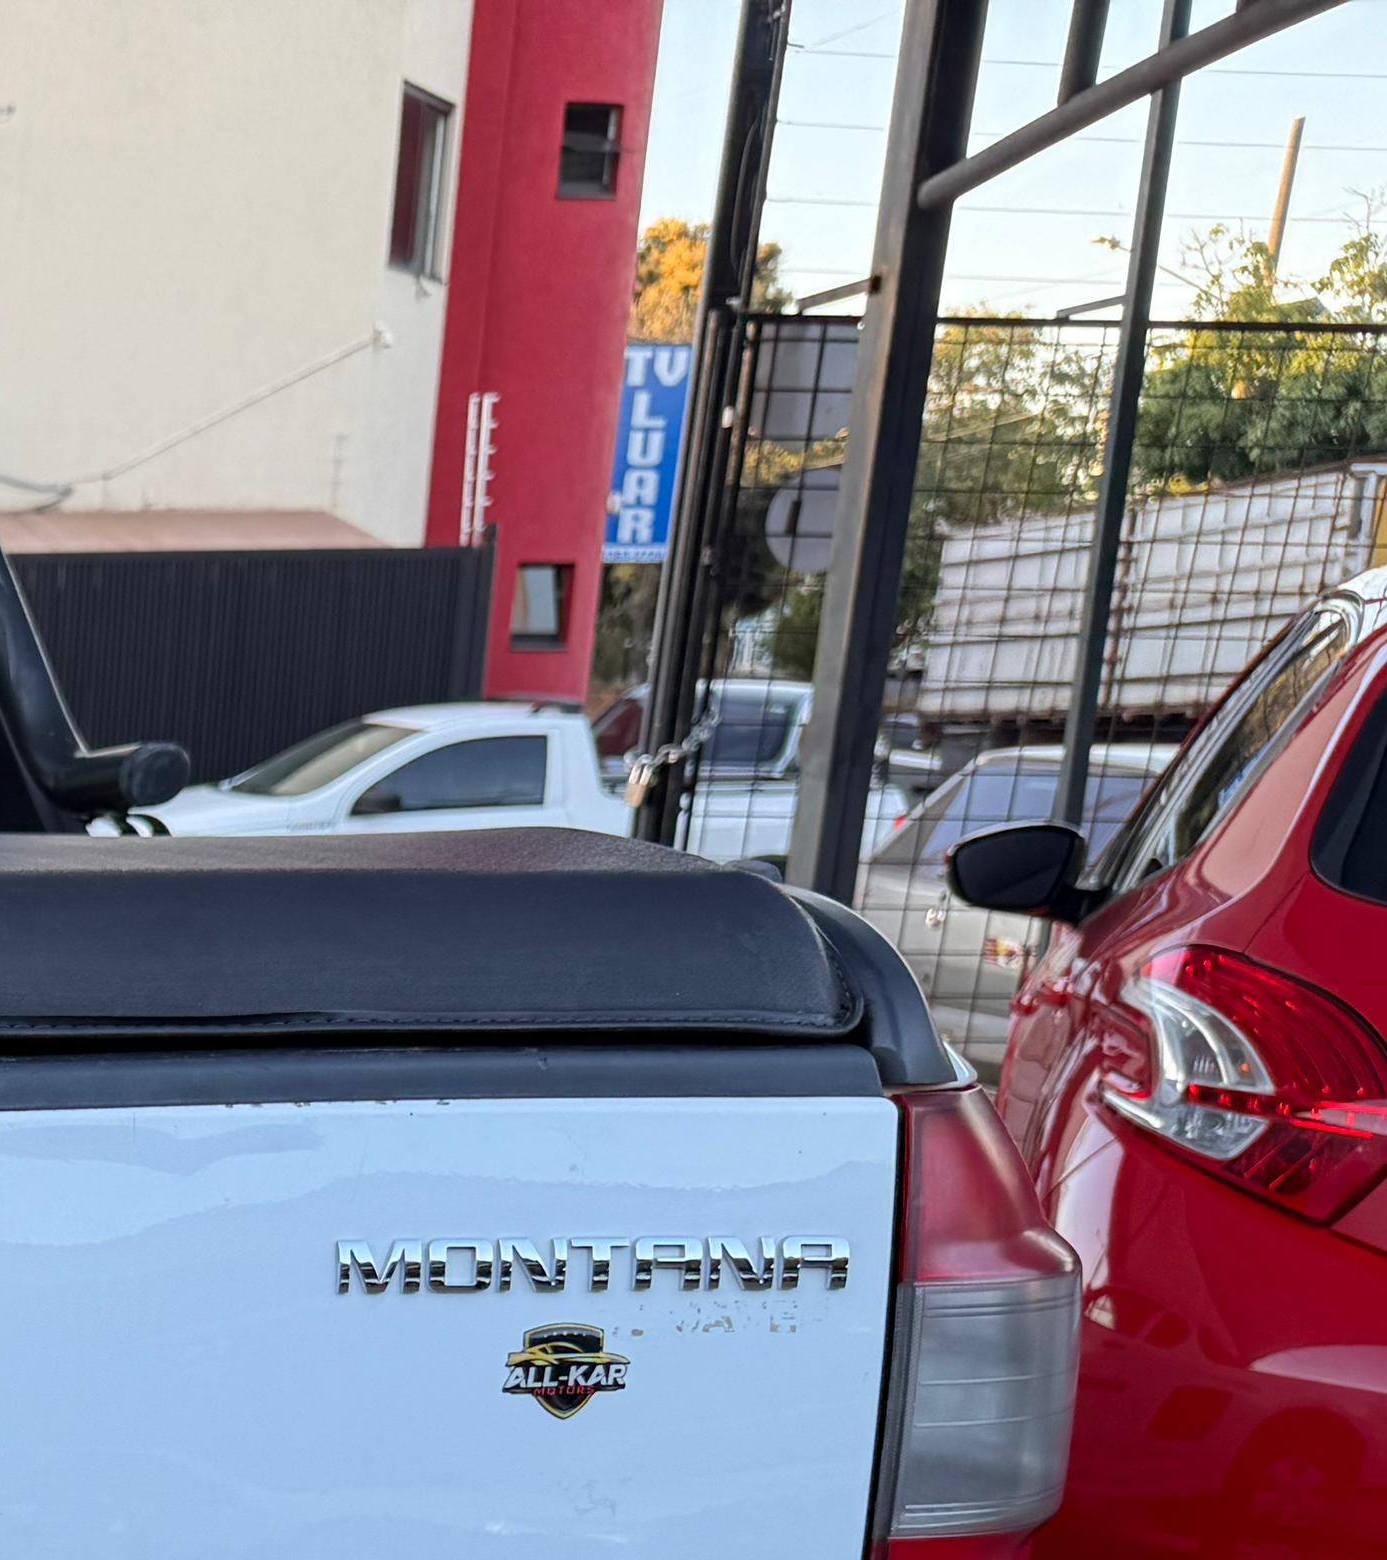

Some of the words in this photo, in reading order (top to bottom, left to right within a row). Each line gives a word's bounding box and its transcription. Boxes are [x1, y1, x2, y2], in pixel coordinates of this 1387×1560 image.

[624, 346, 689, 387] TV
[616, 391, 668, 543] LUAR
[336, 1235, 851, 1295] MONTANA
[503, 1364, 626, 1388] ALL-KAR
[534, 1386, 595, 1396] MOTORS
